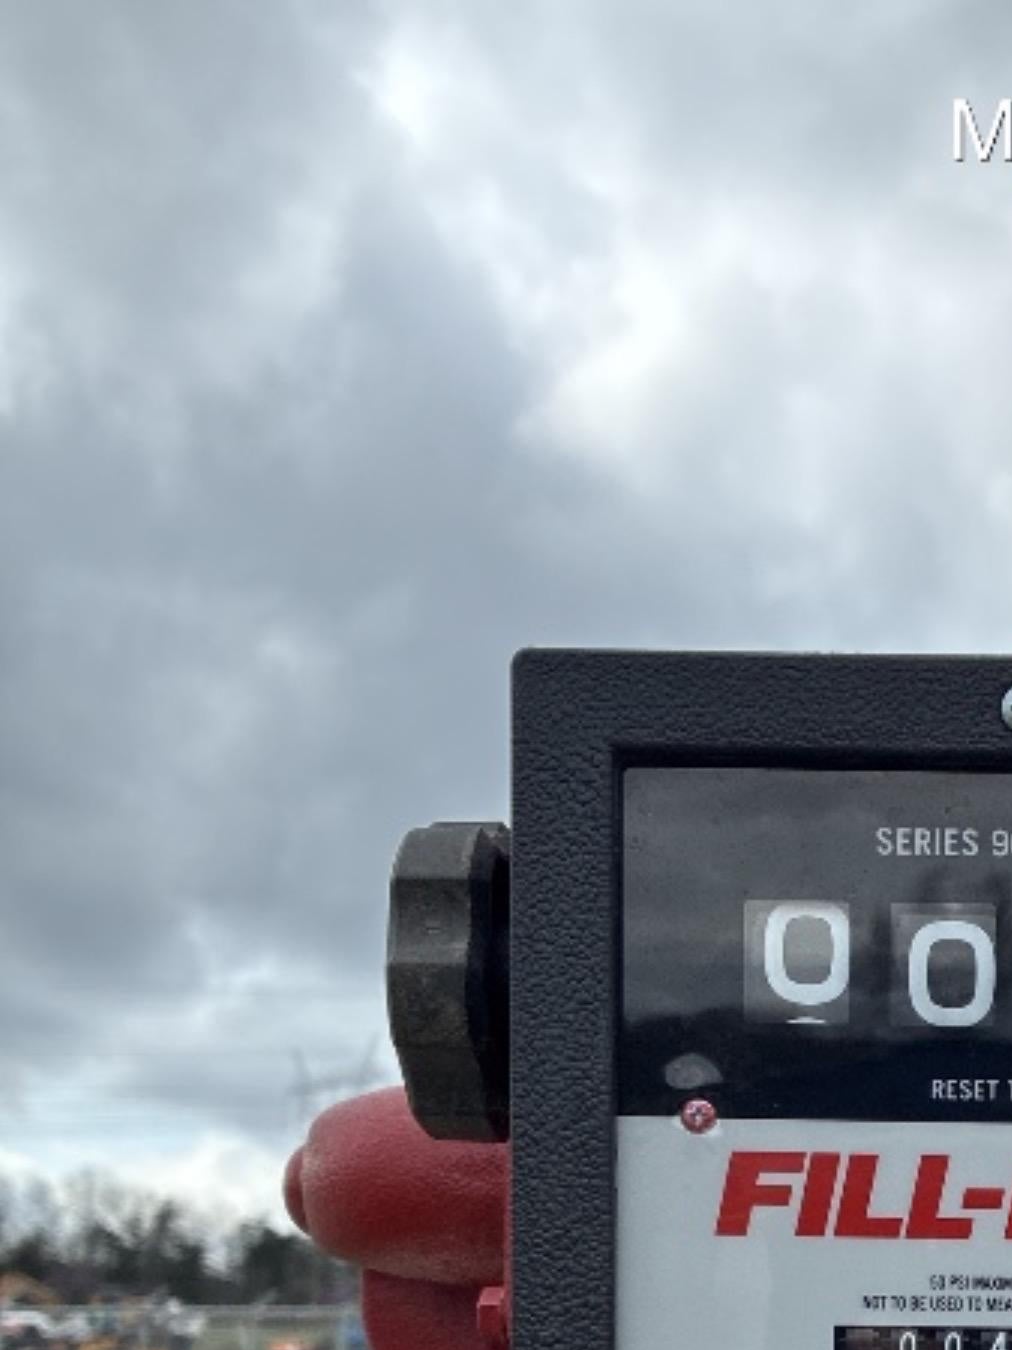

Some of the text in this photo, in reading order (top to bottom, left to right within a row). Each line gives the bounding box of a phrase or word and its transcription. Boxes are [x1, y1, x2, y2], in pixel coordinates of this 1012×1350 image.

[876, 827, 979, 857] SERIES
[931, 1079, 1000, 1101] RESET
[863, 1295, 886, 1310] NOT
[890, 1296, 907, 1310] TO
[911, 1296, 927, 1311] BE
[930, 1297, 963, 1312] USED
[967, 1298, 983, 1312] TO
